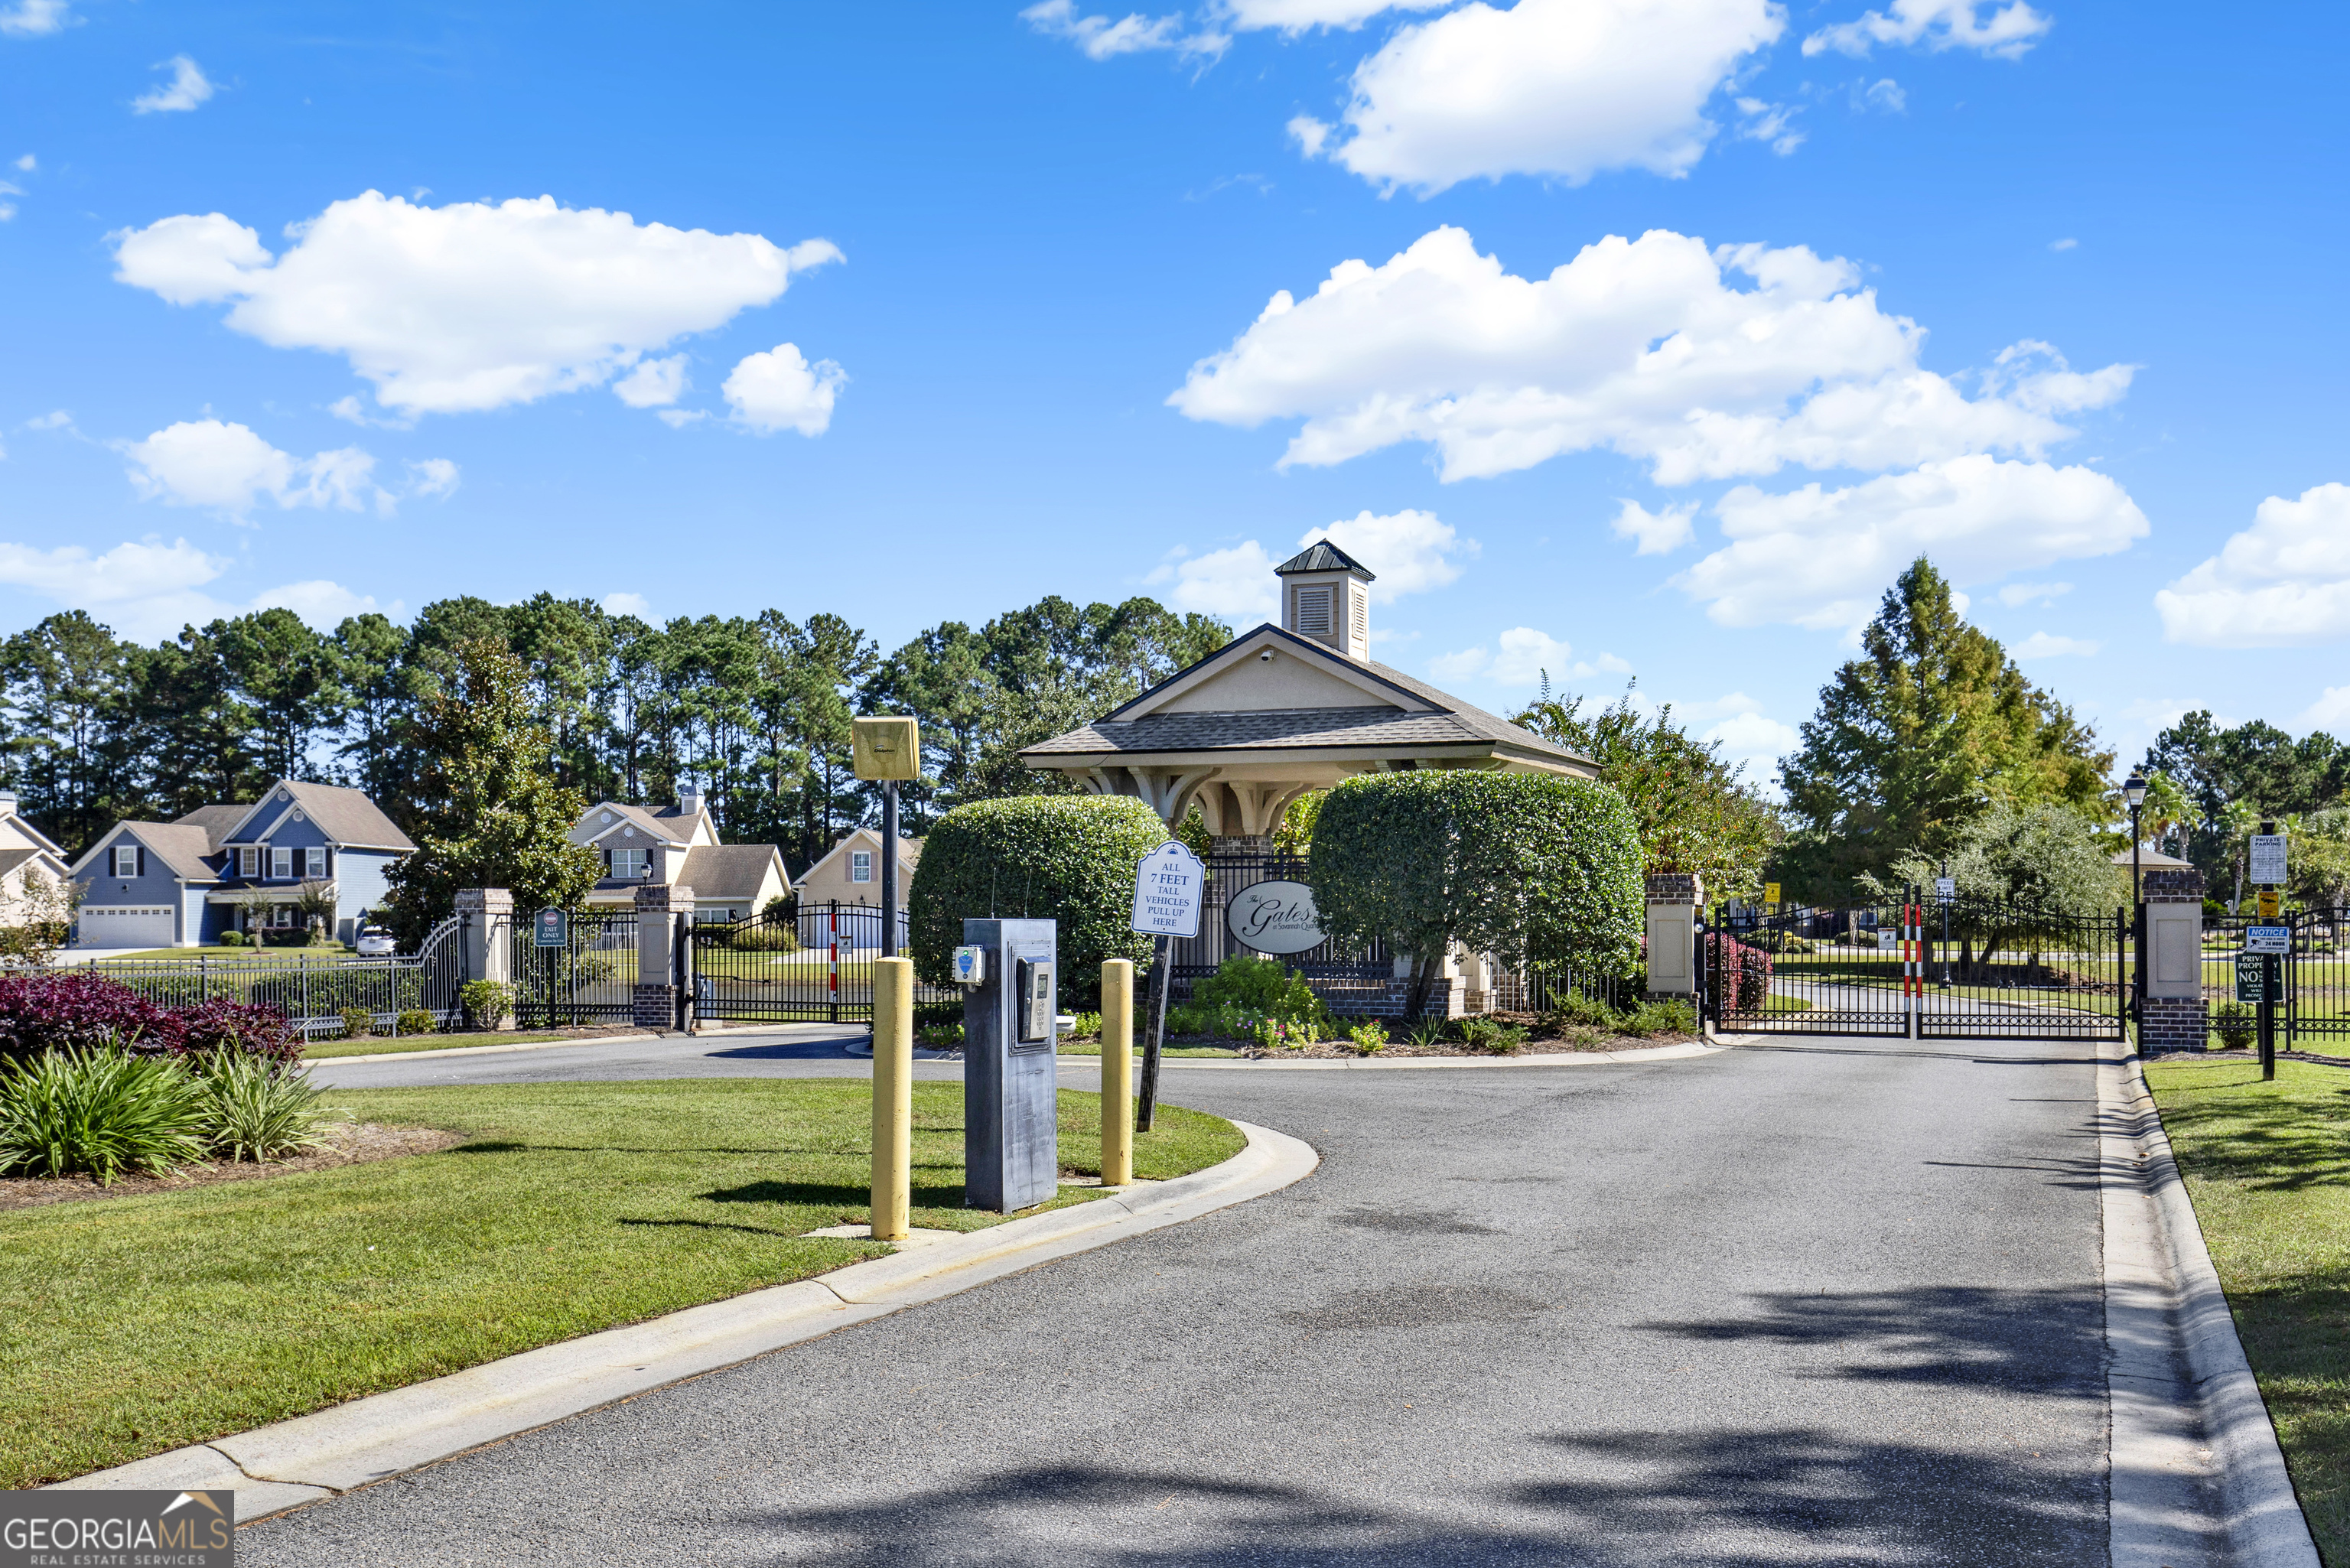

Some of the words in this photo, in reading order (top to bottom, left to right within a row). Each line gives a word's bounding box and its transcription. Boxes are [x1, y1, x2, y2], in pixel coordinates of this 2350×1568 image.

[1162, 863, 1180, 872] ALL
[1151, 873, 1157, 883] 7
[1160, 873, 1190, 886] FEET
[1157, 886, 1180, 896] TALL
[1938, 892, 1952, 900] 25
[1145, 896, 1190, 907] VEHICLES
[1247, 894, 1258, 903] The
[1147, 906, 1170, 916] PULL
[1172, 909, 1185, 917] UP
[1242, 896, 1312, 937] Gates
[1152, 918, 1177, 927] HERE
[2239, 971, 2258, 982] NO
